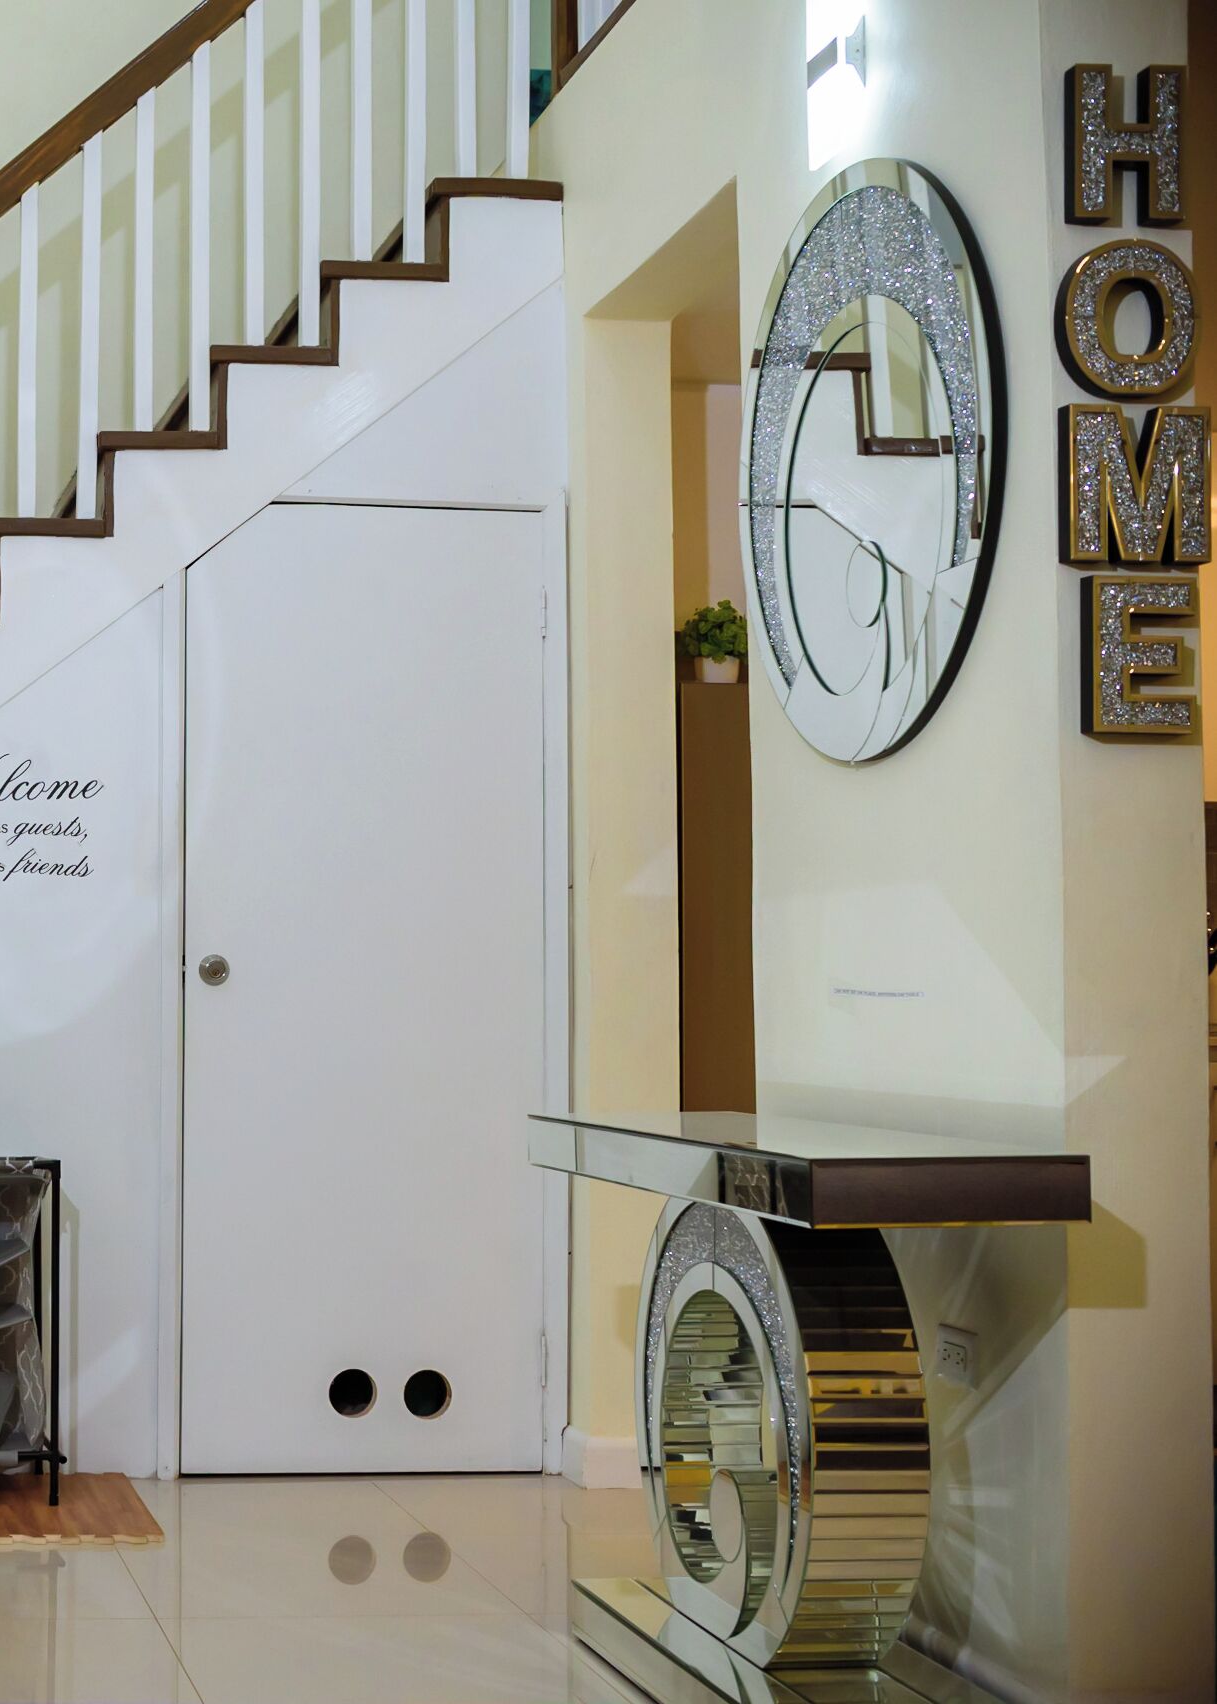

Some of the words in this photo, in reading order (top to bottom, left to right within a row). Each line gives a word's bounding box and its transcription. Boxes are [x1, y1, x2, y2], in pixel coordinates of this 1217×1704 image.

[1055, 62, 1211, 735] HOME
[7, 816, 88, 846] guests,
[2, 848, 94, 881] friends
